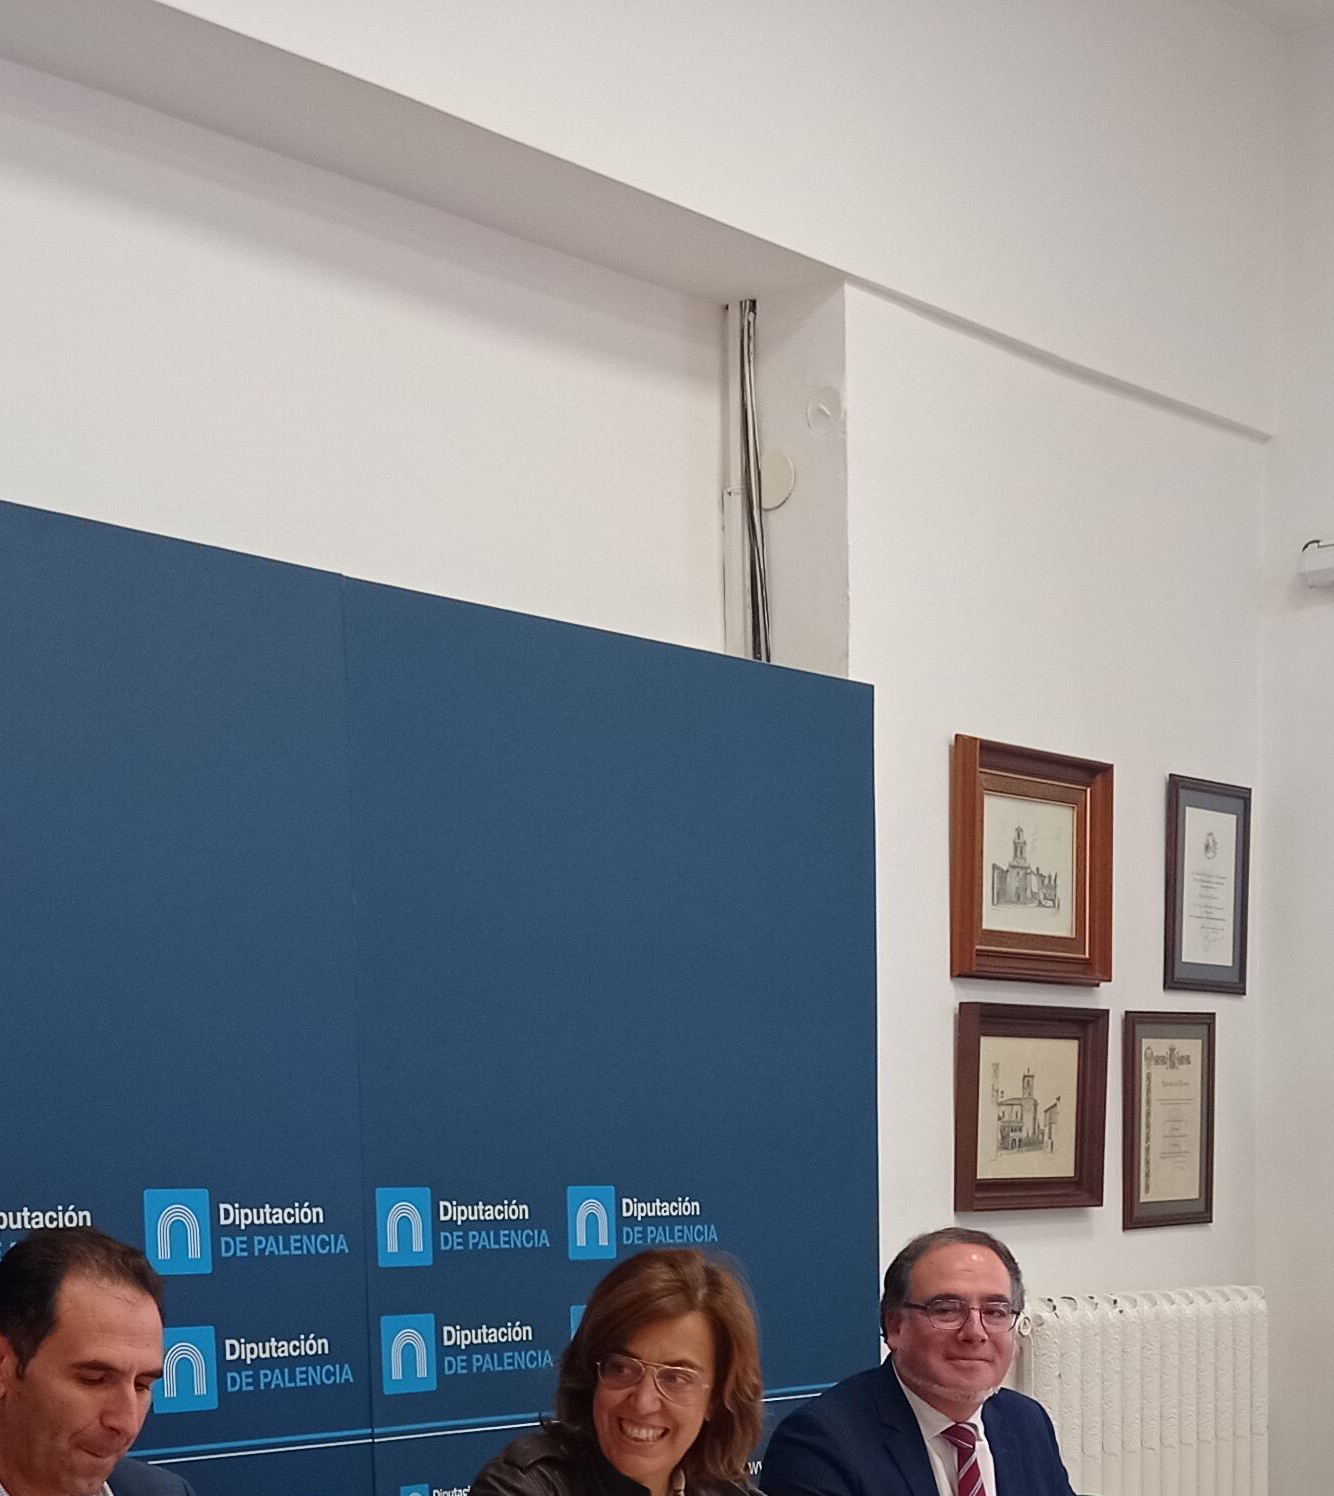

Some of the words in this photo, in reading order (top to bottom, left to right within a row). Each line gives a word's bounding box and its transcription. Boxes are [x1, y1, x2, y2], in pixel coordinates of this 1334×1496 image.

[219, 1202, 323, 1229] Diputación
[440, 1200, 529, 1225] Diputación
[622, 1196, 700, 1220] Diputación
[221, 1237, 248, 1257] DE
[254, 1234, 349, 1256] PALENCIA
[440, 1231, 463, 1250] DE
[469, 1229, 550, 1249] PALENCIA
[623, 1227, 643, 1244] DE
[647, 1225, 718, 1243] PALENCIA
[443, 1321, 532, 1349] Diputación
[222, 1334, 329, 1364] Diputación
[444, 1356, 467, 1375] DE
[473, 1349, 554, 1373] PALENCIA
[227, 1371, 253, 1392] DE
[259, 1364, 353, 1389] PALENCIA
